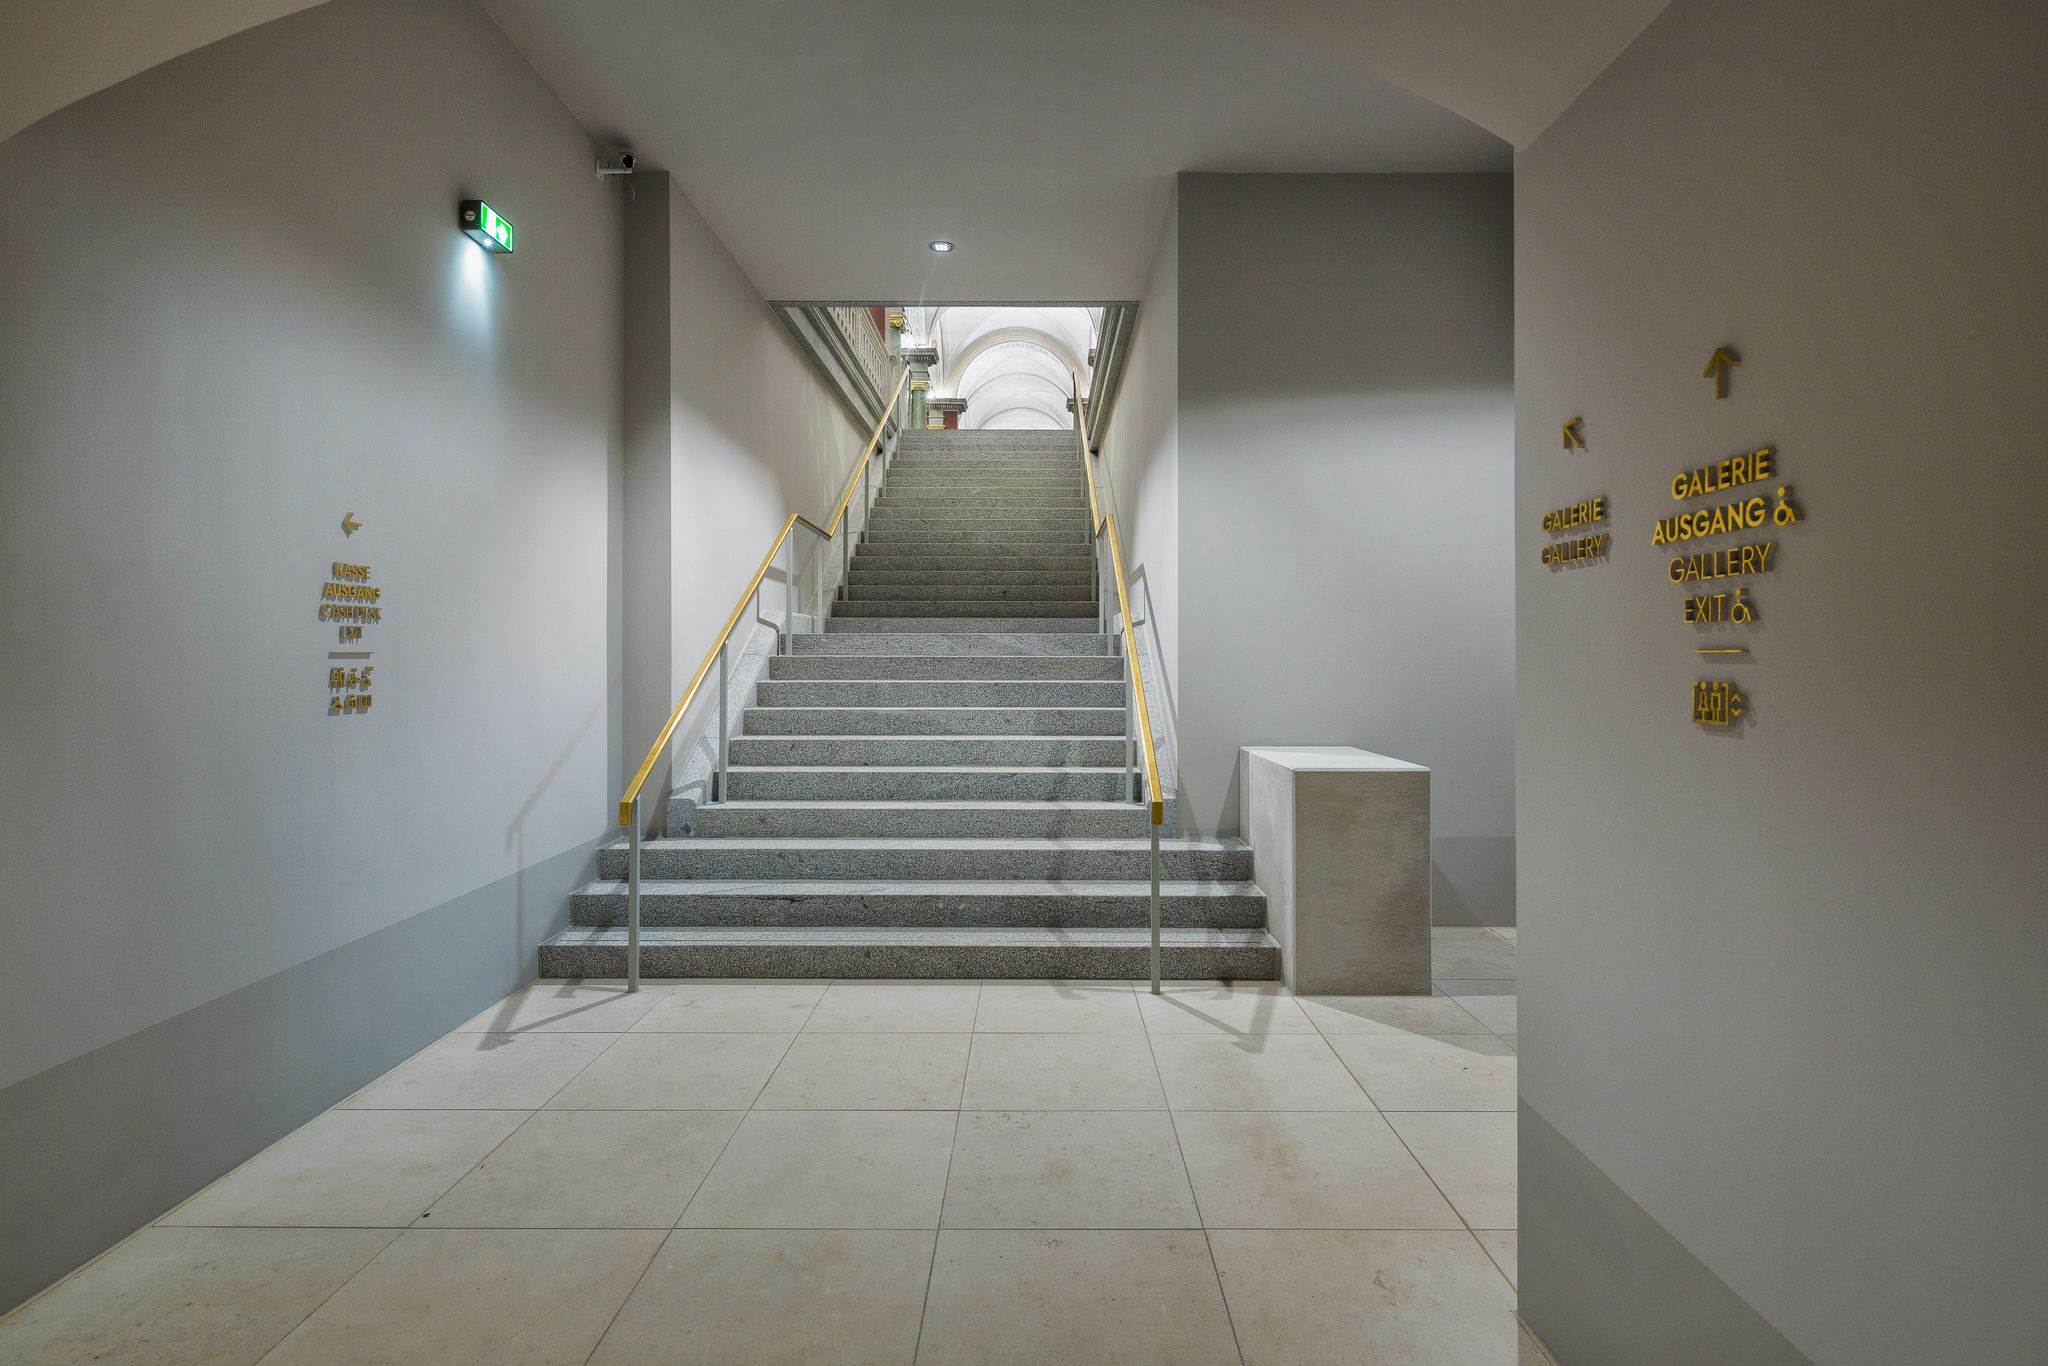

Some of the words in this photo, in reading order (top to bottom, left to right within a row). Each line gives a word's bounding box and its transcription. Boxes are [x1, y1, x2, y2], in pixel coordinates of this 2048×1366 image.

[1671, 449, 1770, 500] GALERIE
[1542, 497, 1603, 534] GALERIE
[1652, 497, 1766, 546] AUSGANG
[1541, 533, 1604, 566] GALLERY
[1668, 542, 1771, 583] GALLERY
[322, 583, 381, 600] AUSGANG
[1683, 594, 1726, 624] EXIT
